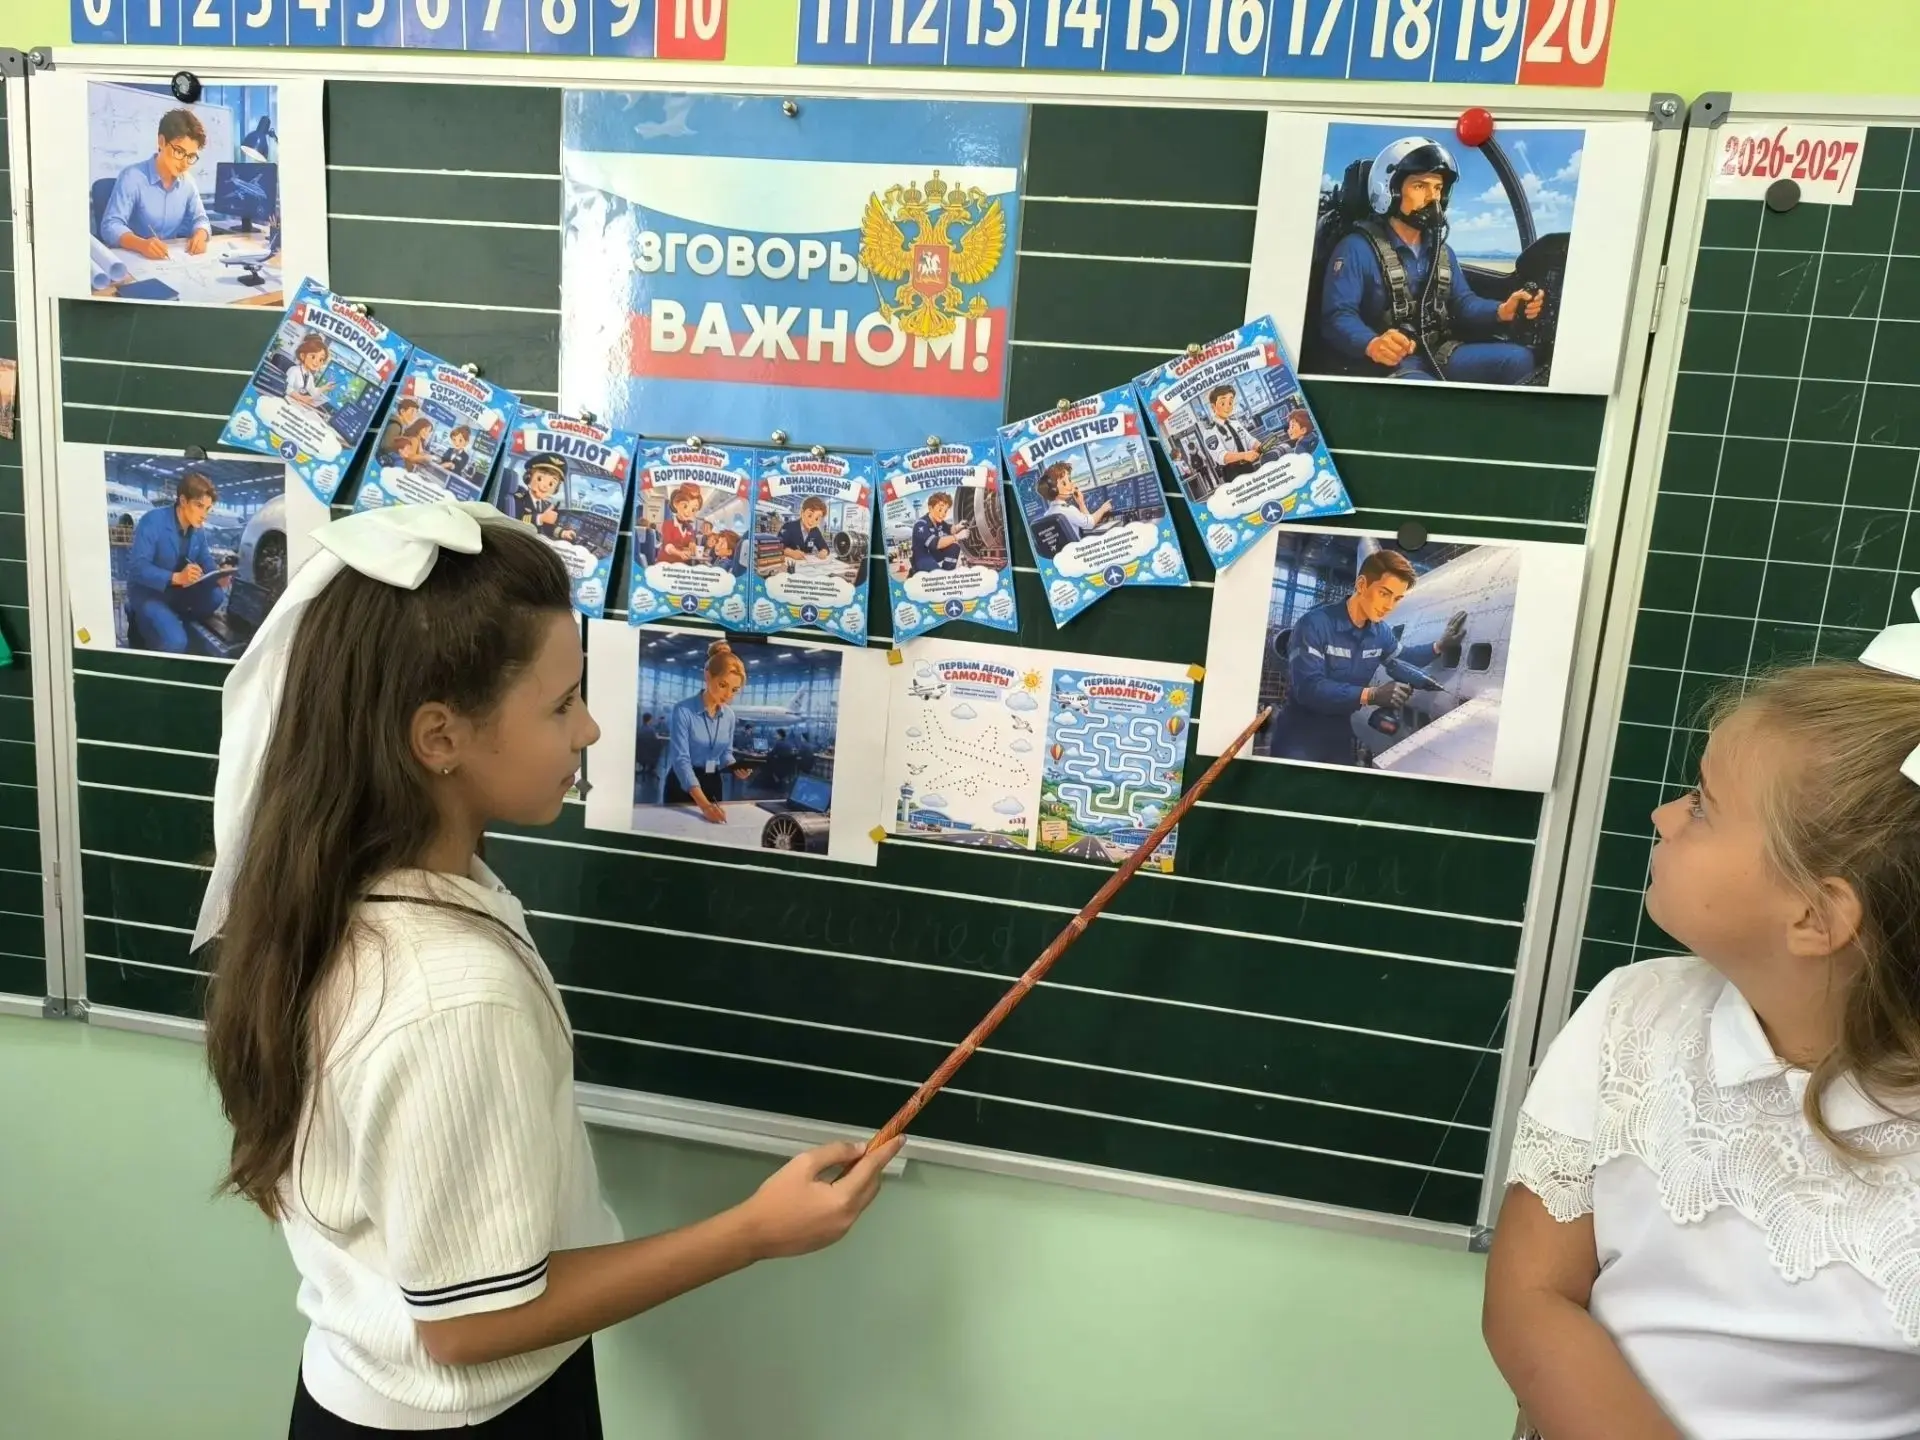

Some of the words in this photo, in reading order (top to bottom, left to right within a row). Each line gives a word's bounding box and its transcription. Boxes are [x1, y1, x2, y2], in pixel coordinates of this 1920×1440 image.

[1287, 0, 1344, 56] 17
[1370, 0, 1431, 61] 18
[1455, 0, 1521, 63] 19
[1525, 0, 1608, 65] 20
[1721, 126, 1858, 193] 2026-2027
[635, 231, 868, 285] ЗГОВОРЫ
[307, 308, 387, 364] МЕТЕОРОЛОГ
[650, 299, 992, 374] ВАЖНОМ!
[1164, 371, 1205, 403] СПЕЦИАЛИСТ
[1204, 364, 1215, 380] ПО
[1214, 346, 1261, 373] АВИАЦИОННОЙ
[1180, 362, 1250, 402] БЕЗОПАСНОСТИ
[429, 383, 485, 413] СОТРУДНИК
[430, 392, 480, 420] АЭРОПОРТА
[536, 432, 612, 466] ПИЛОТ
[1028, 416, 1119, 463] ДИСПЕТЧЕР
[670, 454, 722, 468] САМОЛЁТЫ
[789, 463, 842, 476] САМОЛЁТЫ
[911, 455, 966, 469] САМОЛЁТЫ
[653, 469, 738, 489] БОРТПРОВОДНИК
[779, 475, 852, 491] АВИАЦИОННЫЙ
[904, 466, 976, 485] АВИАЦИОННЫЙ
[917, 476, 964, 490] ТЕХНИК
[790, 485, 840, 496] ИНЖЕНЕР
[938, 661, 980, 673] ПЕРВЫМ
[981, 663, 1015, 678] ДЕЛОМ
[943, 671, 1010, 687] САМОЛЁТЫ
[1084, 676, 1126, 688] ПЕРВЫМ
[1128, 678, 1162, 693] ДЕЛОМ
[1088, 686, 1157, 702] САМОЛЁТЫ
